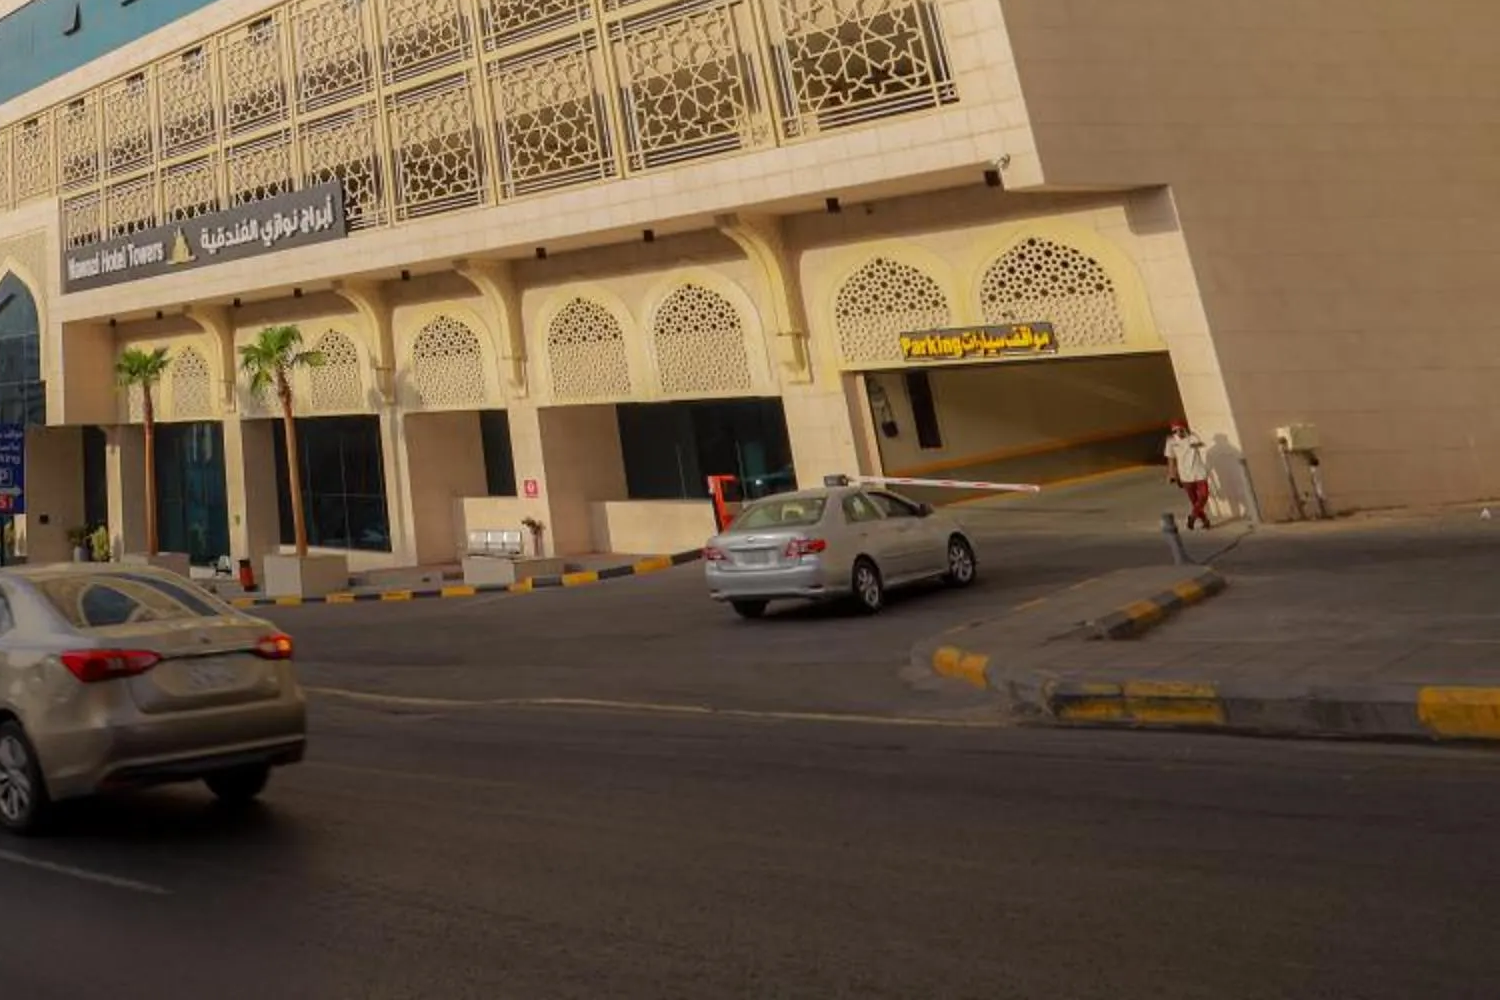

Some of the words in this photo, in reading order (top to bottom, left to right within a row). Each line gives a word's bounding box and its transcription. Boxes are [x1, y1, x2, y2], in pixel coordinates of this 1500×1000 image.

[200, 217, 260, 255] الفندقية
[261, 207, 299, 248] نوازي
[101, 244, 127, 274] Hotel
[127, 241, 164, 269] Towers
[900, 334, 963, 358] Parking
